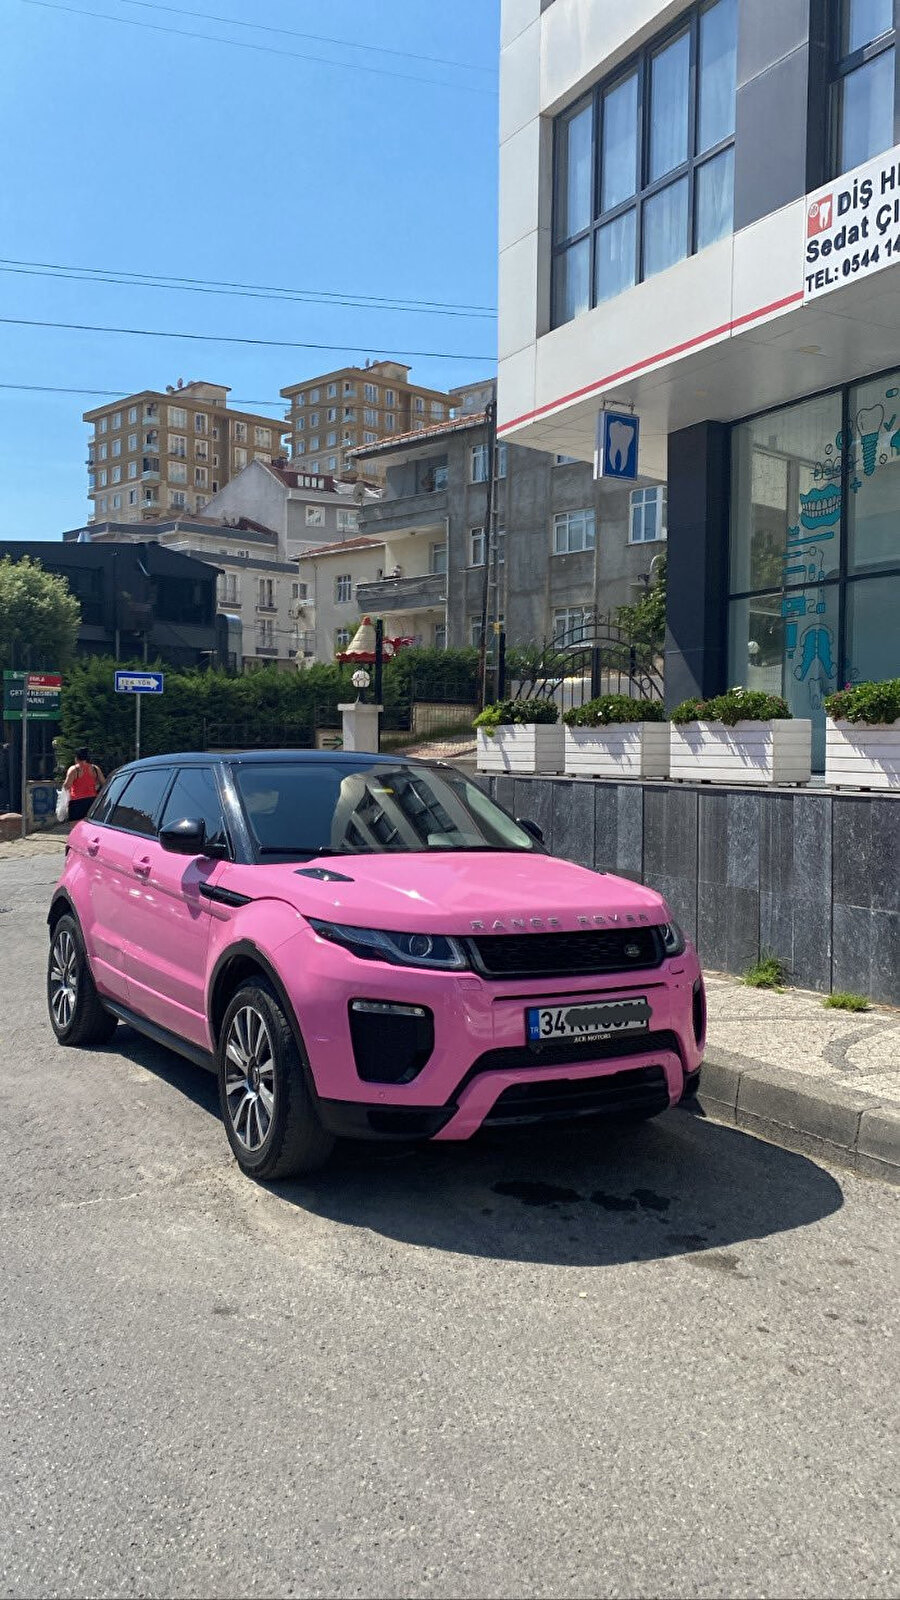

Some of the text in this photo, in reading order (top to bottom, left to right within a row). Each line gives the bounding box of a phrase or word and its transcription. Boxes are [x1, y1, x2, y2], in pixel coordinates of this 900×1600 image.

[837, 178, 873, 216] DİŞ
[806, 216, 869, 263] Sedat
[805, 267, 839, 293] TEL:
[842, 244, 880, 277] 0544
[471, 914, 648, 930] RANGE ROVER
[530, 1026, 539, 1034] TR
[540, 1009, 566, 1035] 34
